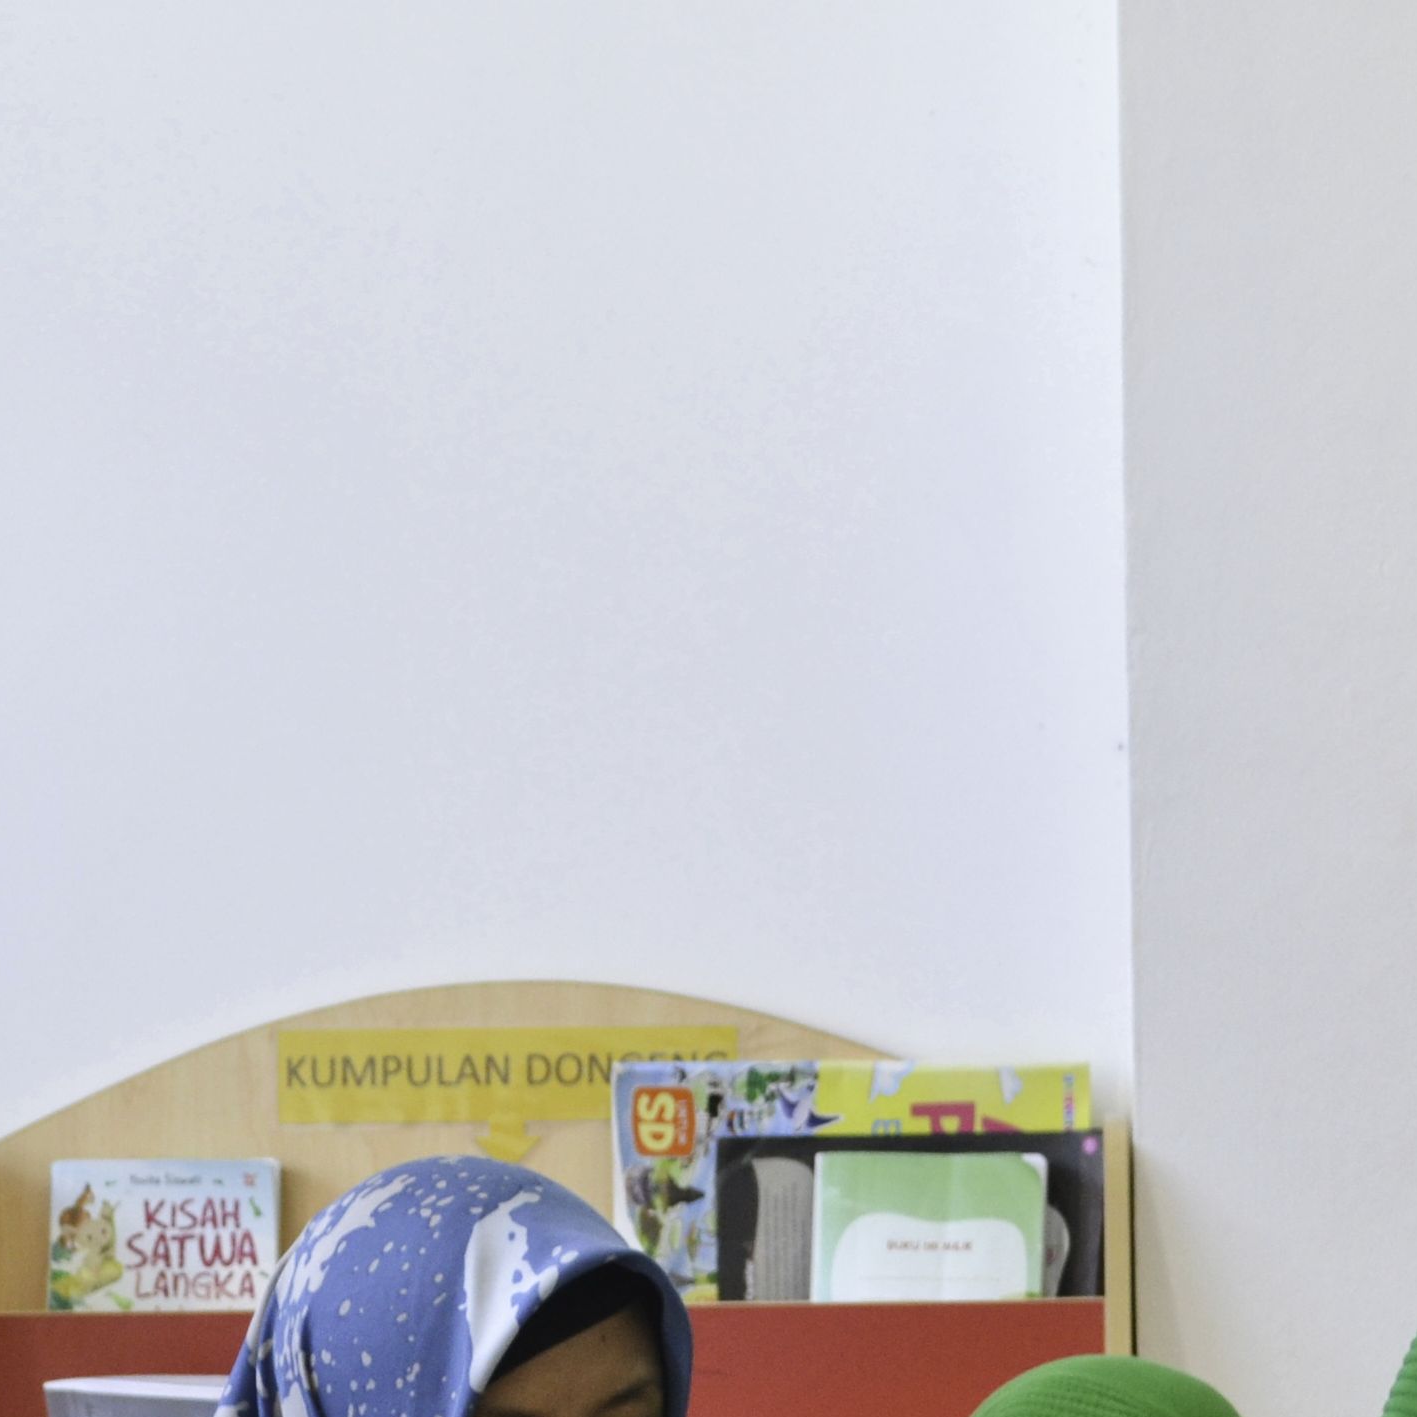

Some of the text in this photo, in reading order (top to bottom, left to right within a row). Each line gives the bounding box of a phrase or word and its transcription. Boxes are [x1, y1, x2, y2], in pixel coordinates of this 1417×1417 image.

[286, 1052, 511, 1088] KUMPULAN
[637, 1091, 675, 1152] SD
[144, 1197, 242, 1230] KISAH
[125, 1230, 258, 1268] SATWA
